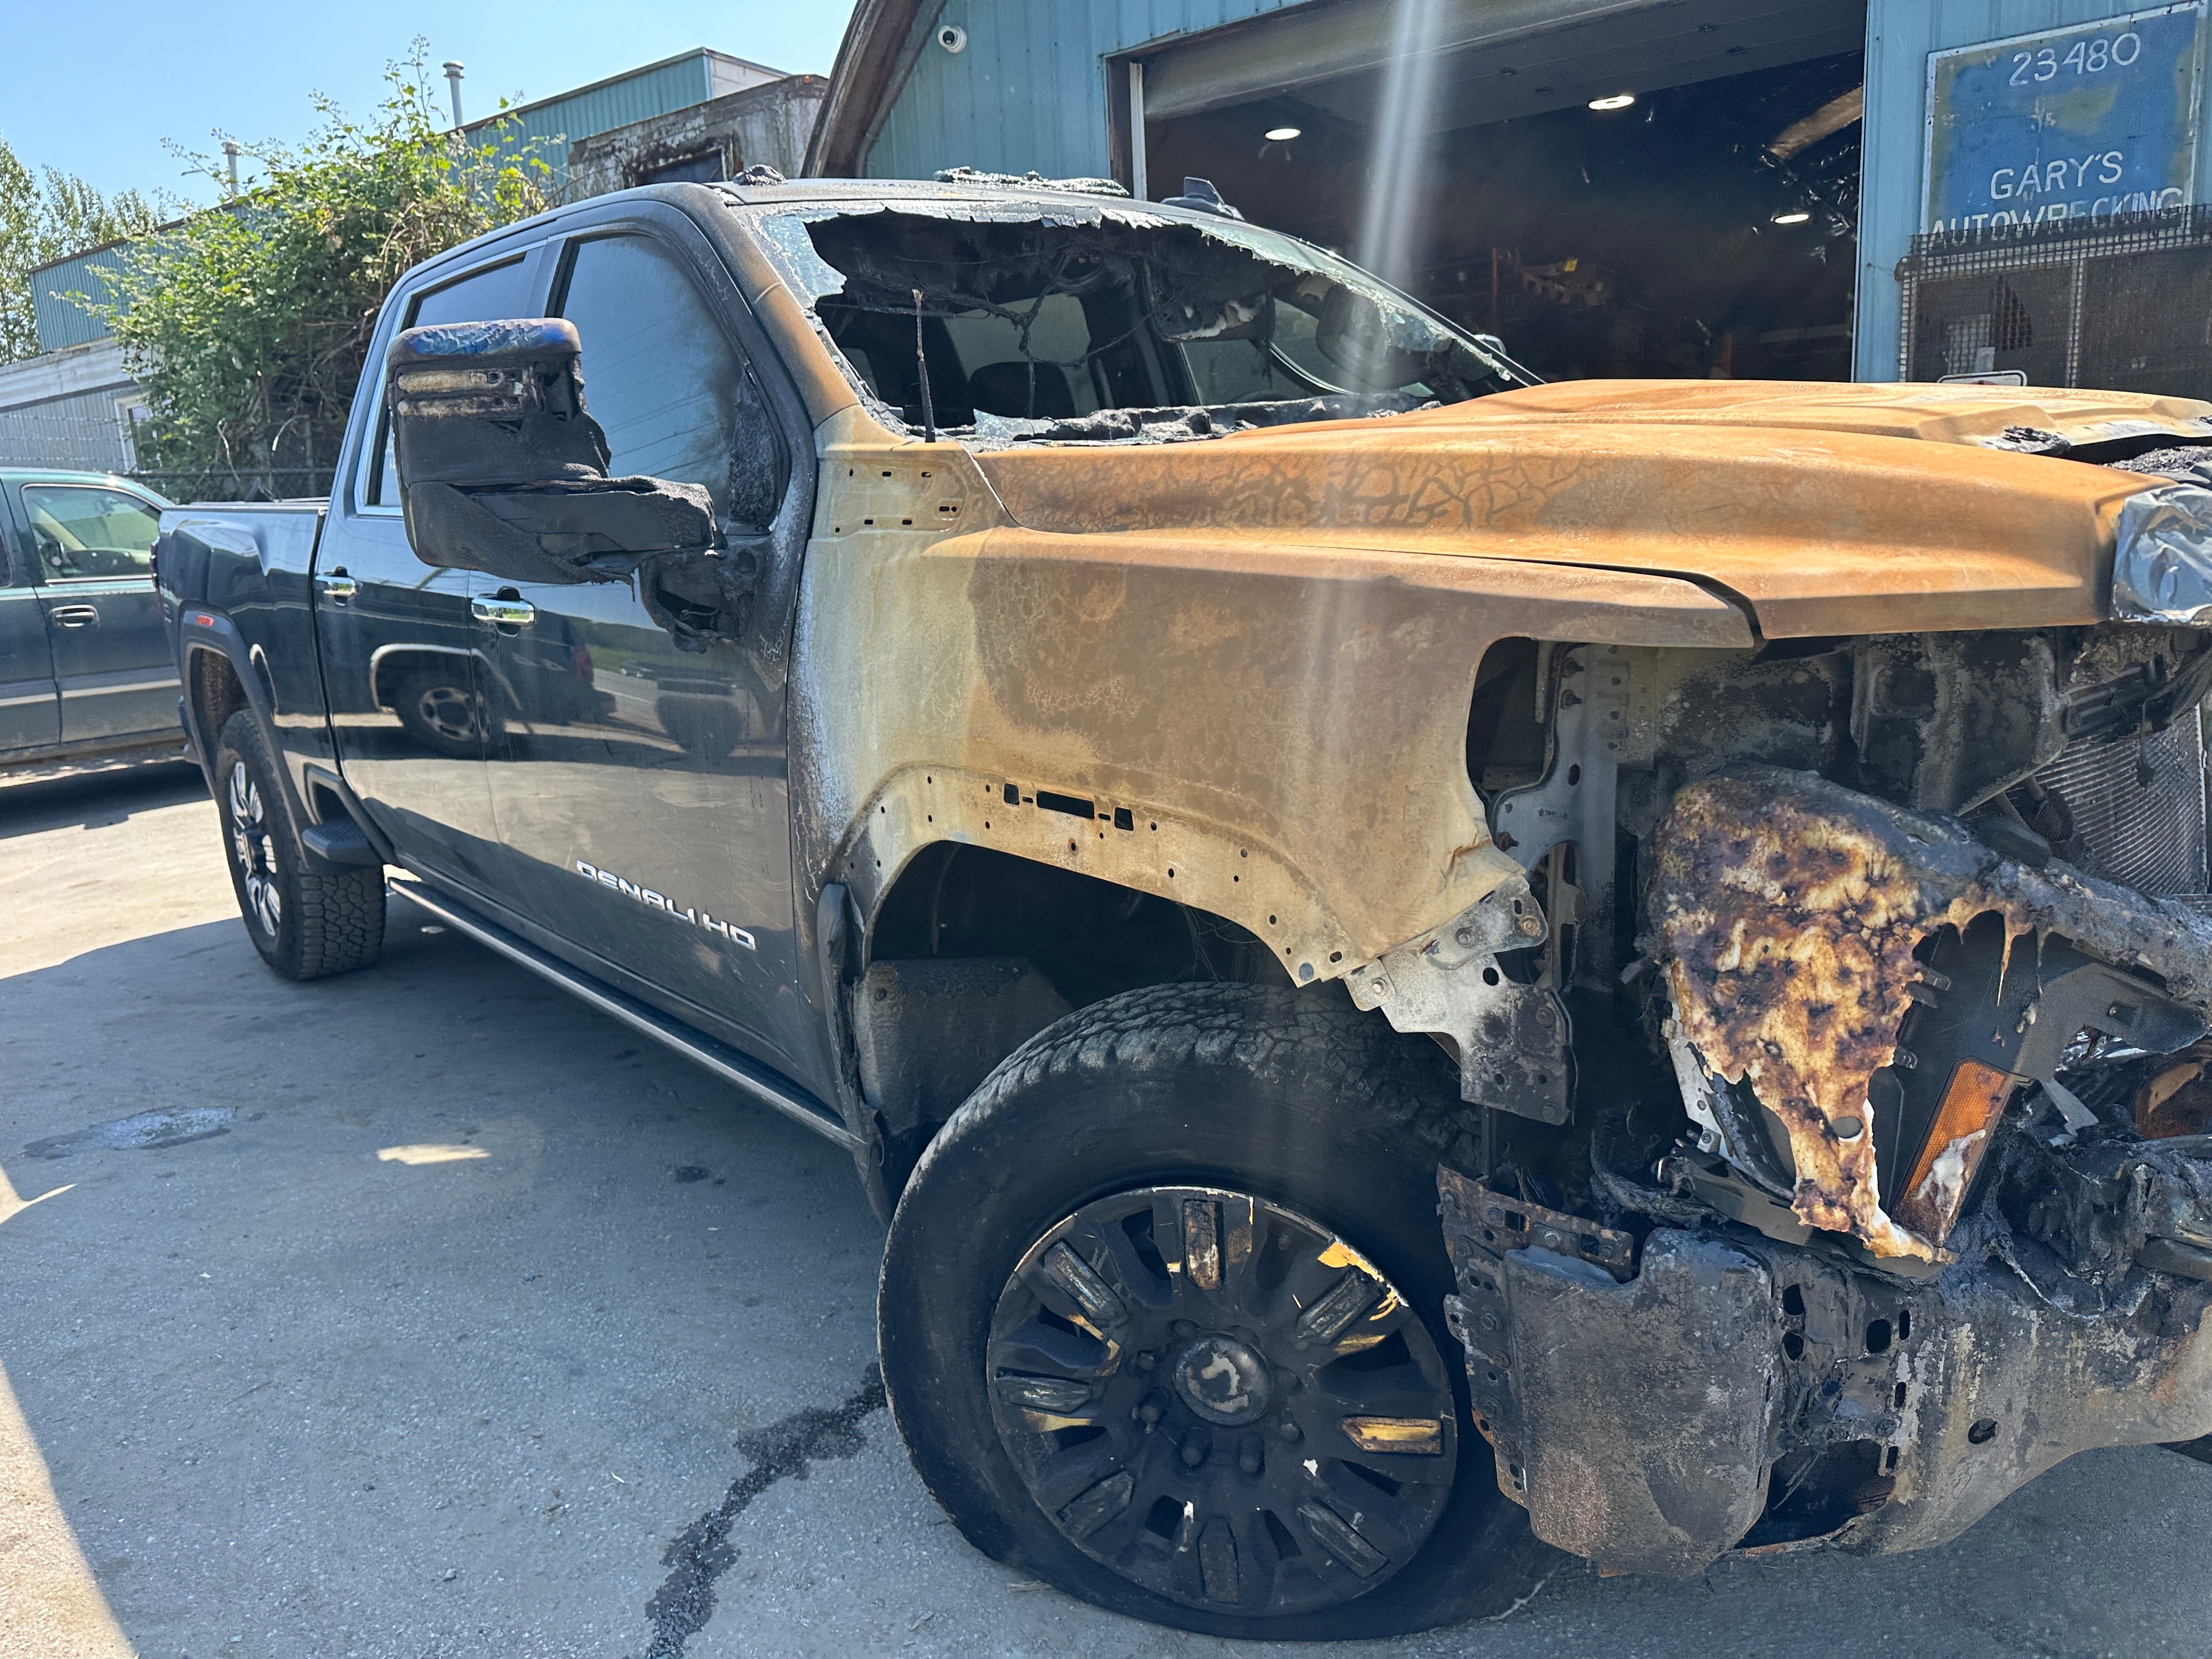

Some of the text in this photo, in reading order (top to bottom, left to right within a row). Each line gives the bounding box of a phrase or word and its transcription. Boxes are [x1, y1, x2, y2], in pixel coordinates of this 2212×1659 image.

[2008, 32, 2141, 86] 23480
[1990, 150, 2123, 200] GARY'S
[576, 859, 756, 950] DENALI HD
